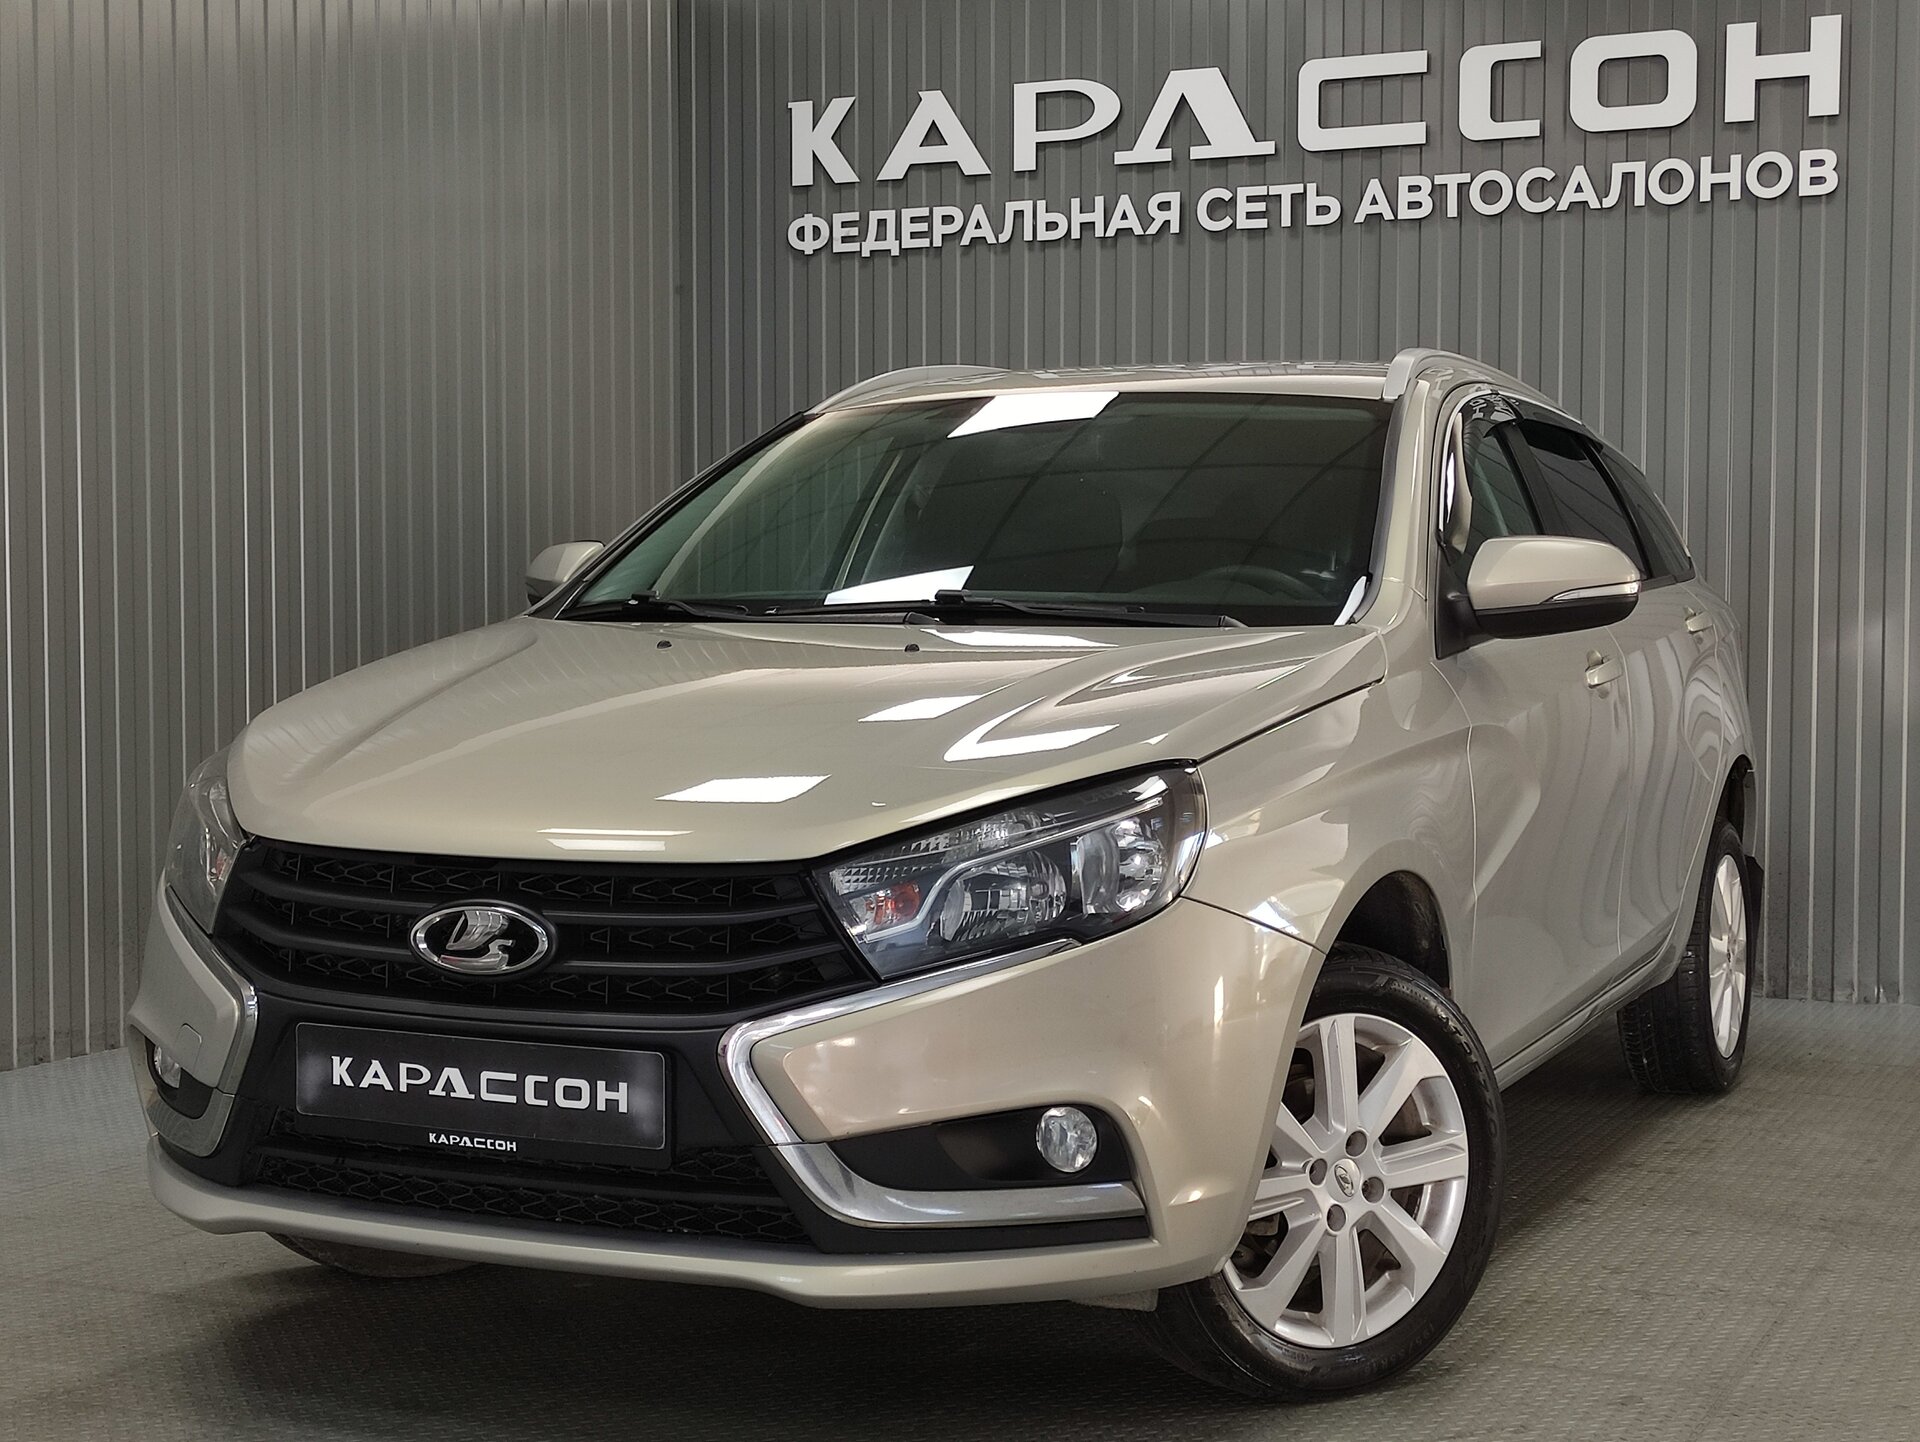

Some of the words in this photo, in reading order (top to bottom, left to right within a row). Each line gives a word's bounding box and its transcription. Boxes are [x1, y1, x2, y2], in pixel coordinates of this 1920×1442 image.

[787, 191, 1181, 257] ФЕДЕРАЛЬНАЯ
[1196, 182, 1342, 232] СЕТЬ
[1353, 148, 1840, 224] АВТОСАЛОНОВ
